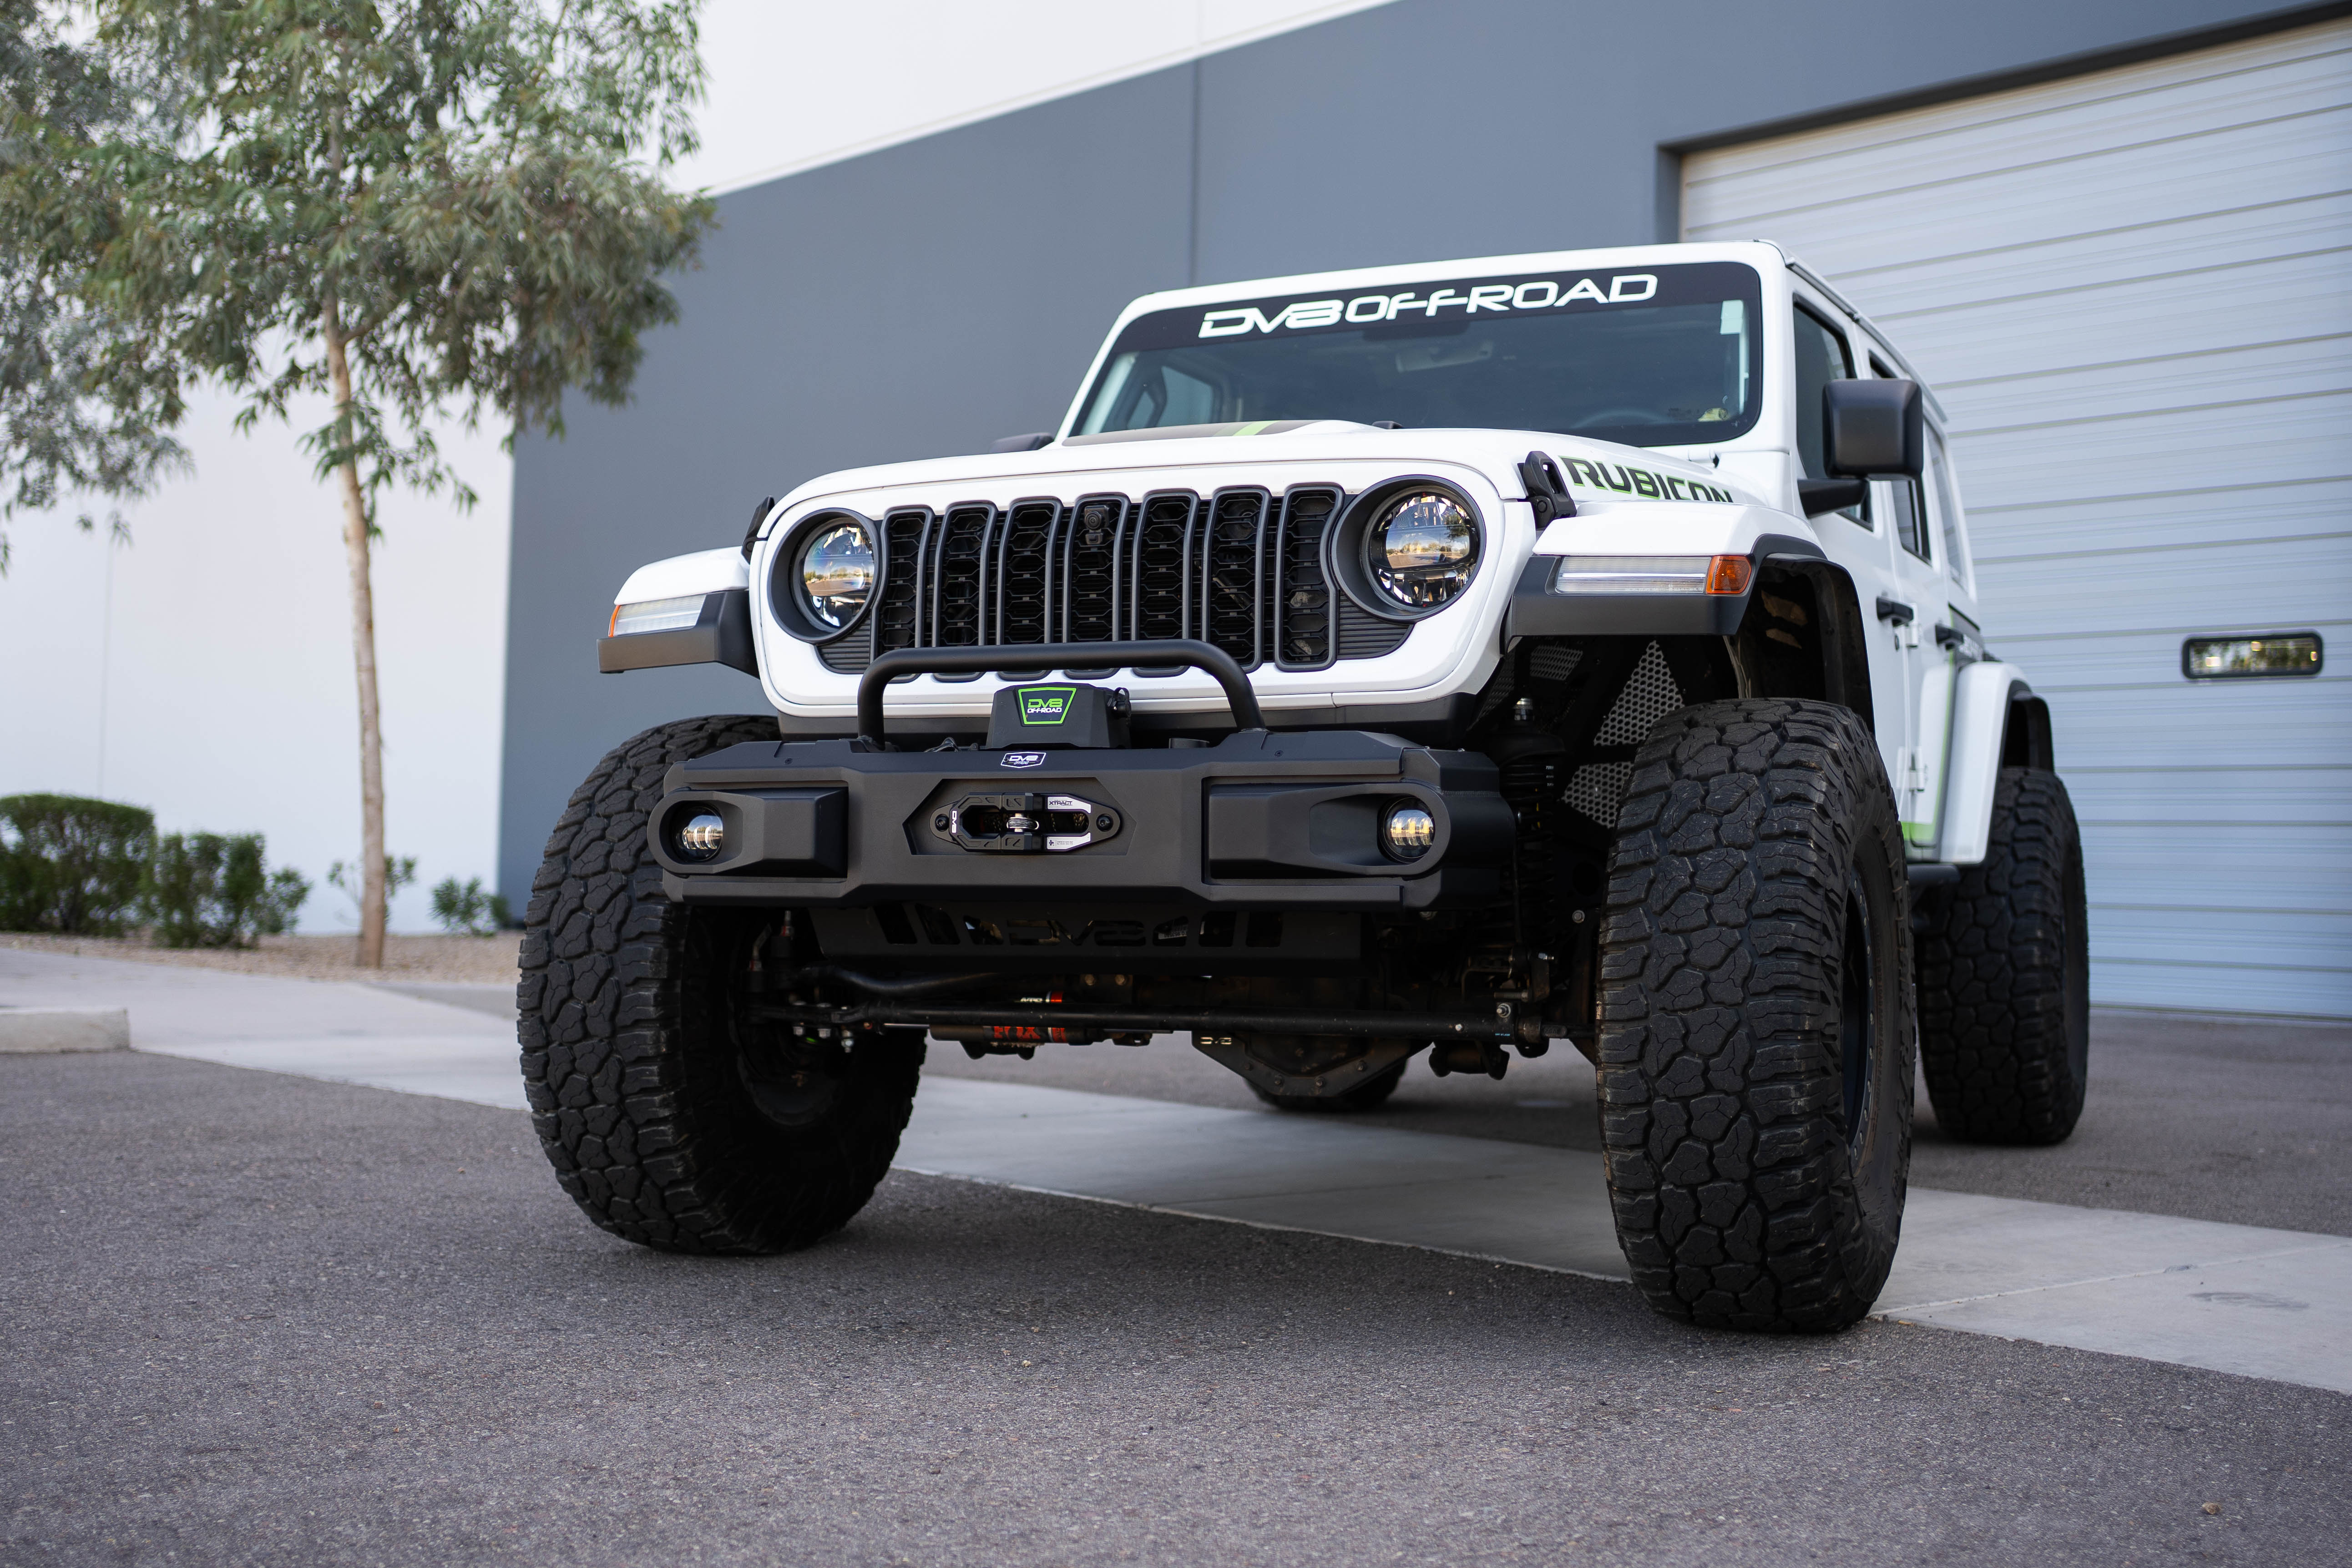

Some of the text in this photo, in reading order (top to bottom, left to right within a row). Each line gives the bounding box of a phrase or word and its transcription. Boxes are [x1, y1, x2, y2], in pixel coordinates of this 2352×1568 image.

[1198, 298, 1344, 338] DV8
[1558, 456, 1734, 502] RUBICON
[1027, 698, 1063, 708] DV8
